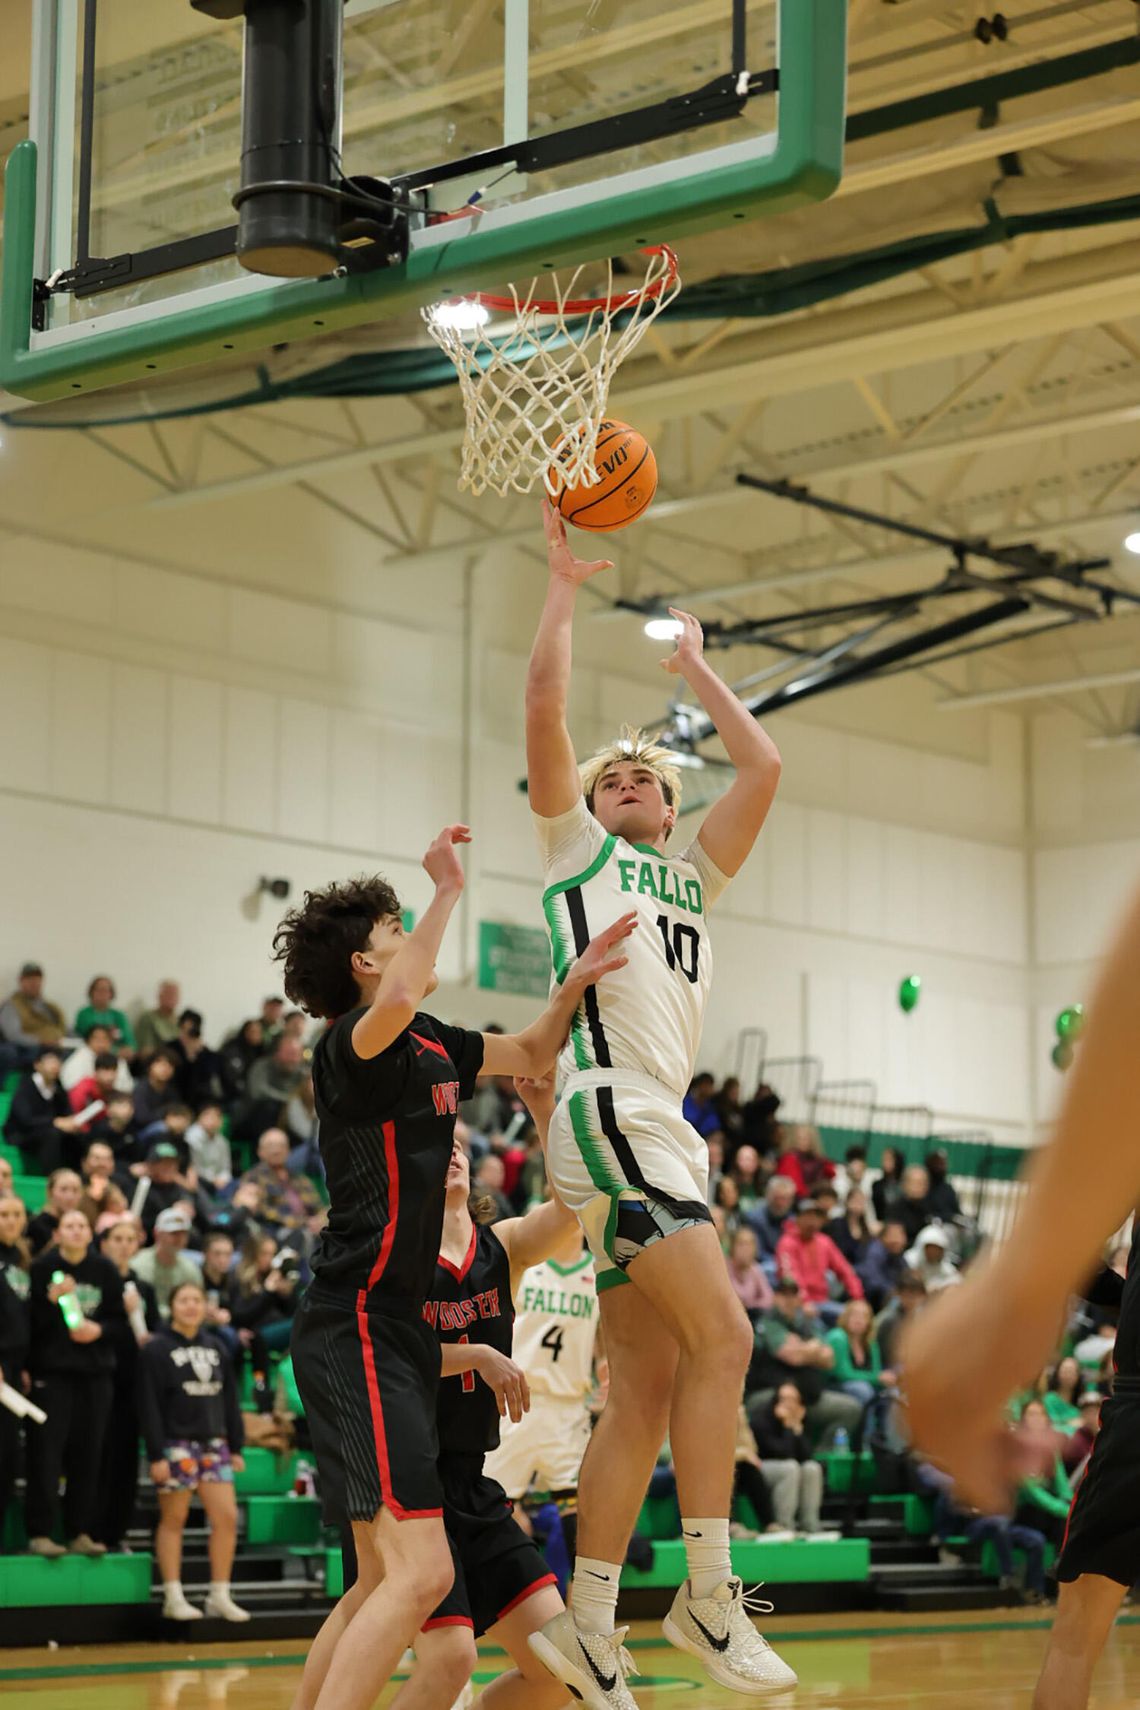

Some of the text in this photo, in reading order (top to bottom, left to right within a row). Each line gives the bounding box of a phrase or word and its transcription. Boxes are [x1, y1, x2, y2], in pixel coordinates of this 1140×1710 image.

[617, 859, 703, 915] FALLO
[656, 914, 700, 984] 10
[422, 1288, 501, 1331] WOOSTER
[523, 1287, 595, 1320] FALLON
[541, 1325, 564, 1363] 4
